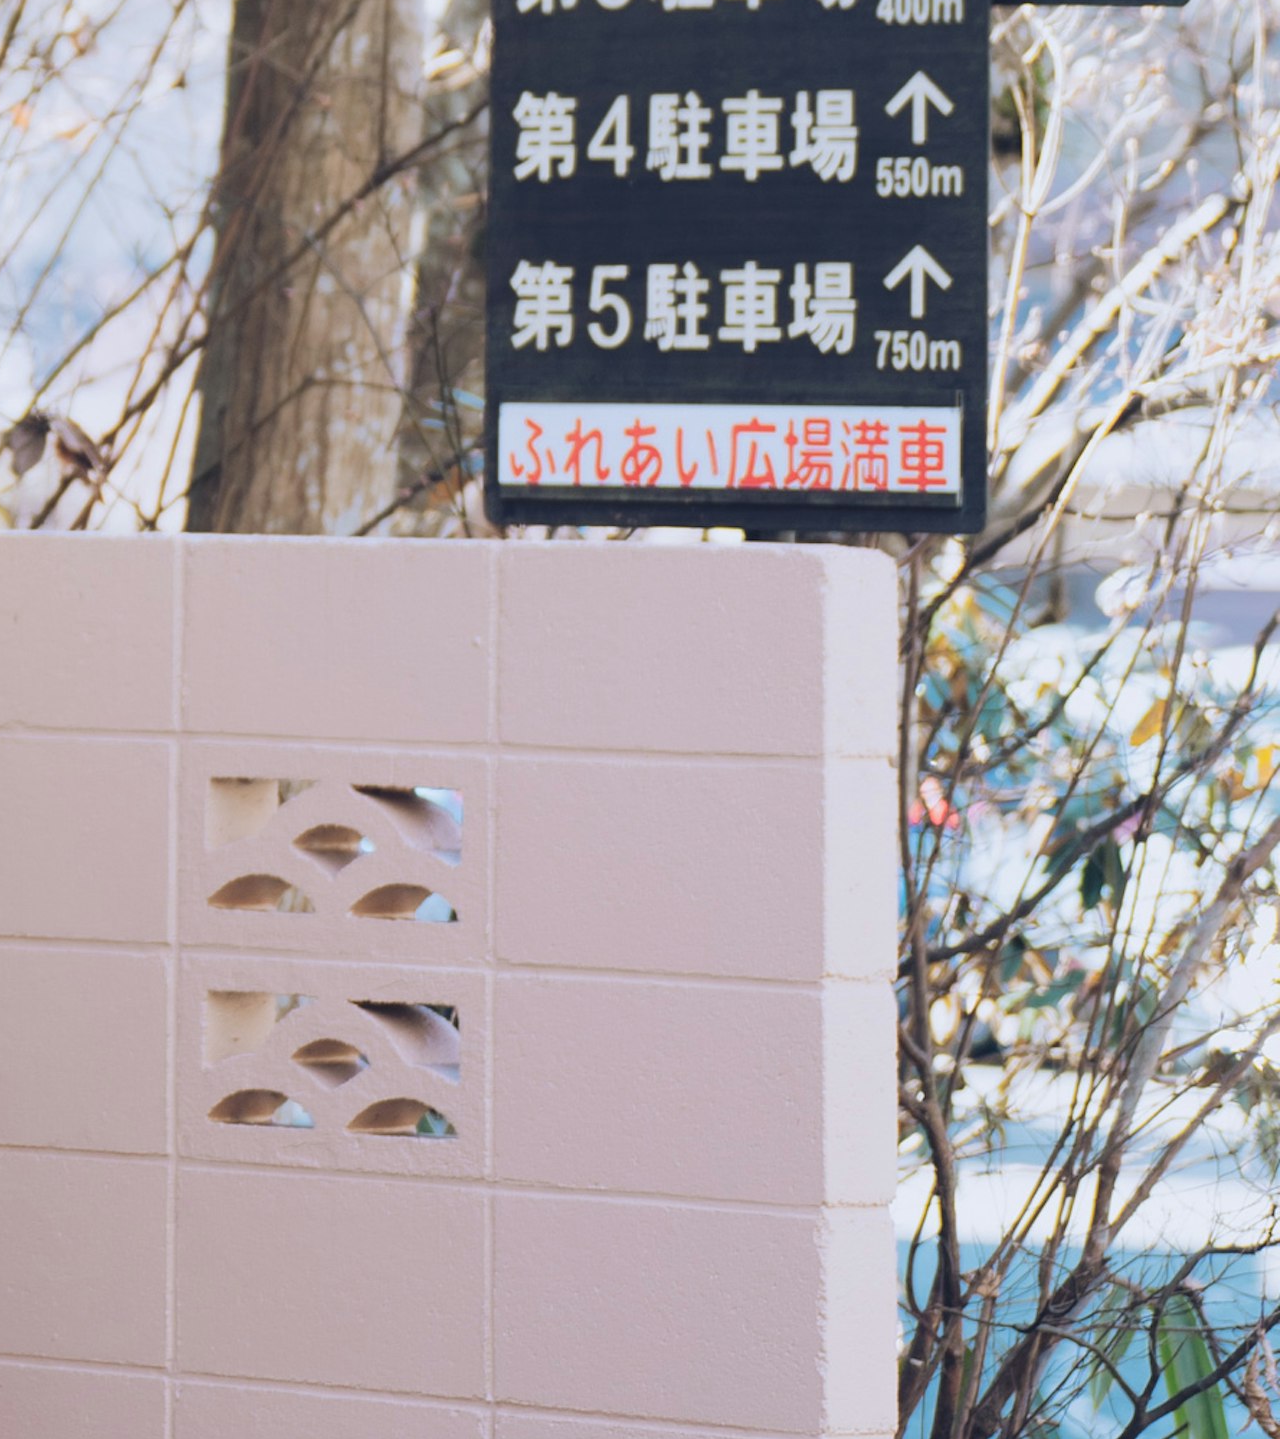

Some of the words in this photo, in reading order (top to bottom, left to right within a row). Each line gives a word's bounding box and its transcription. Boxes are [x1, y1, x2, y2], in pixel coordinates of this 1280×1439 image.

[511, 88, 859, 183] 第4駐車場
[875, 156, 964, 198] 550m
[509, 259, 857, 355] 第5駐車場
[874, 329, 961, 372] 750m
[509, 417, 948, 492] ふれあい広場満車
